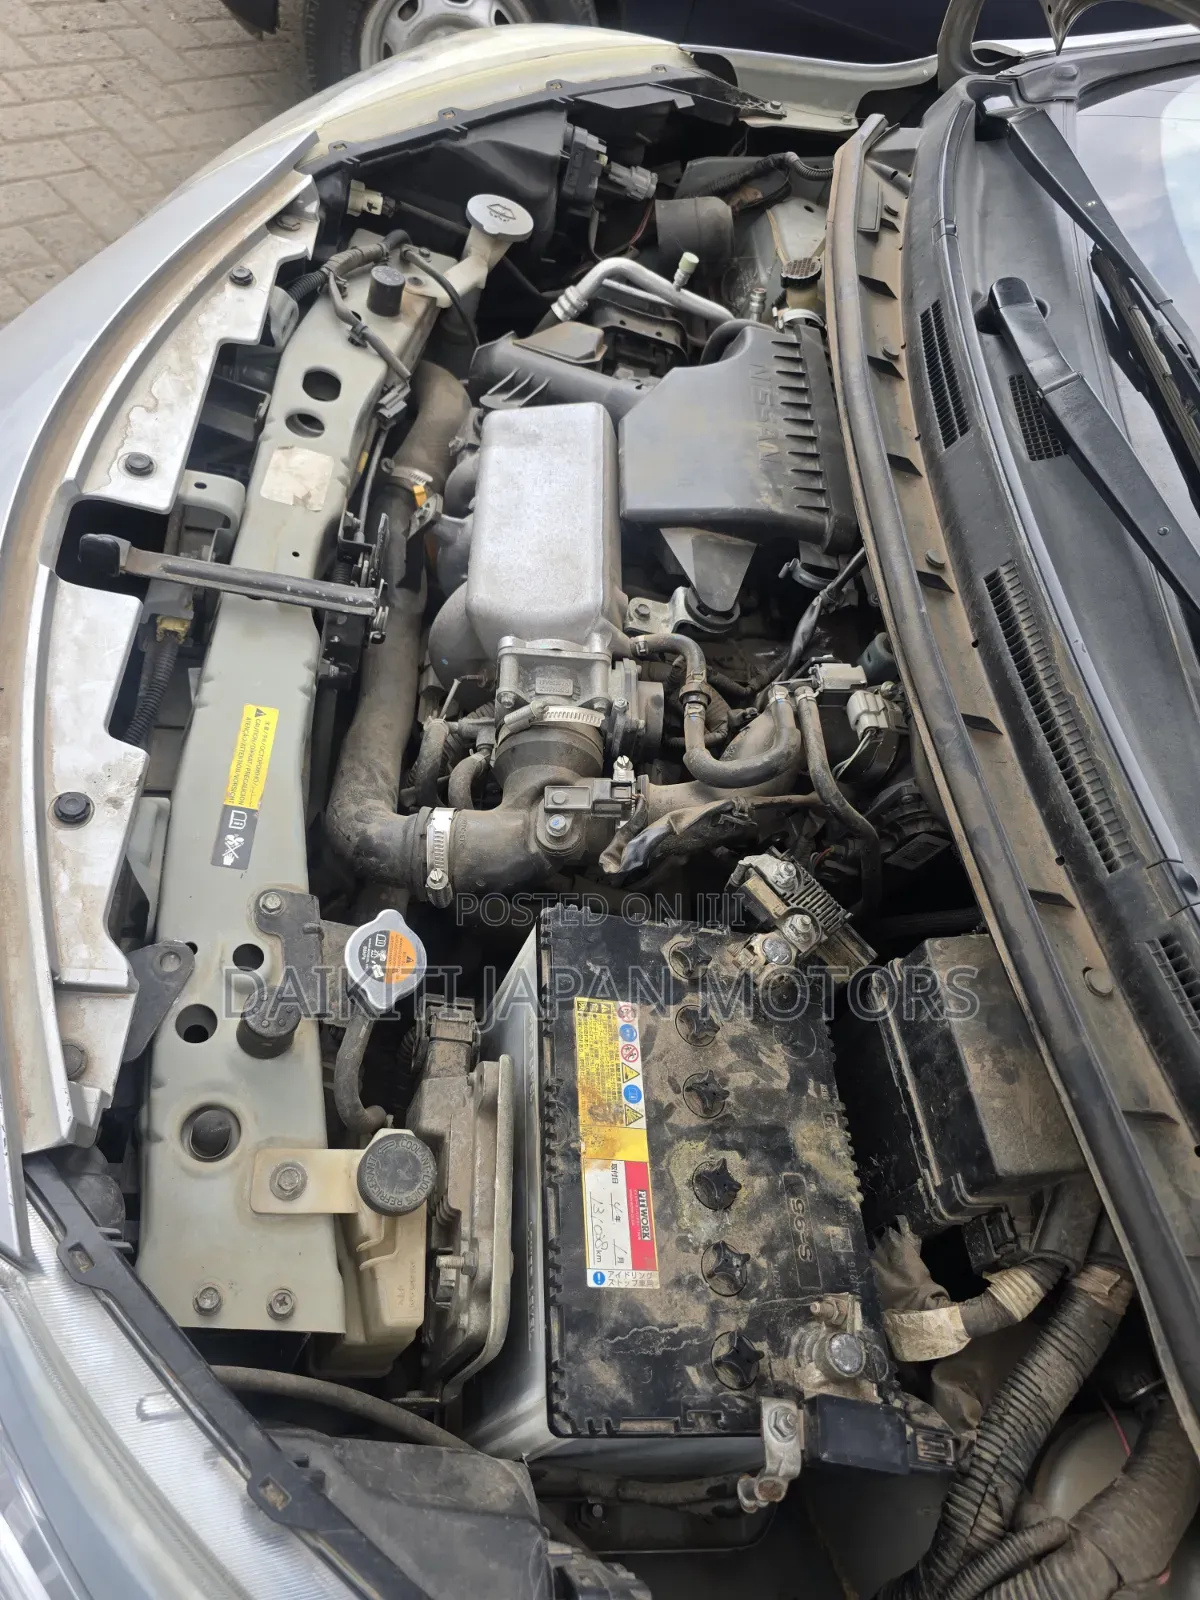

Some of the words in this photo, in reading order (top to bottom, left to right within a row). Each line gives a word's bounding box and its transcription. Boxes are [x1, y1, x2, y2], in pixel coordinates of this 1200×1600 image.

[748, 363, 781, 463] NISSAN
[611, 1163, 619, 1184] 取付日
[790, 1199, 813, 1262] S-95
